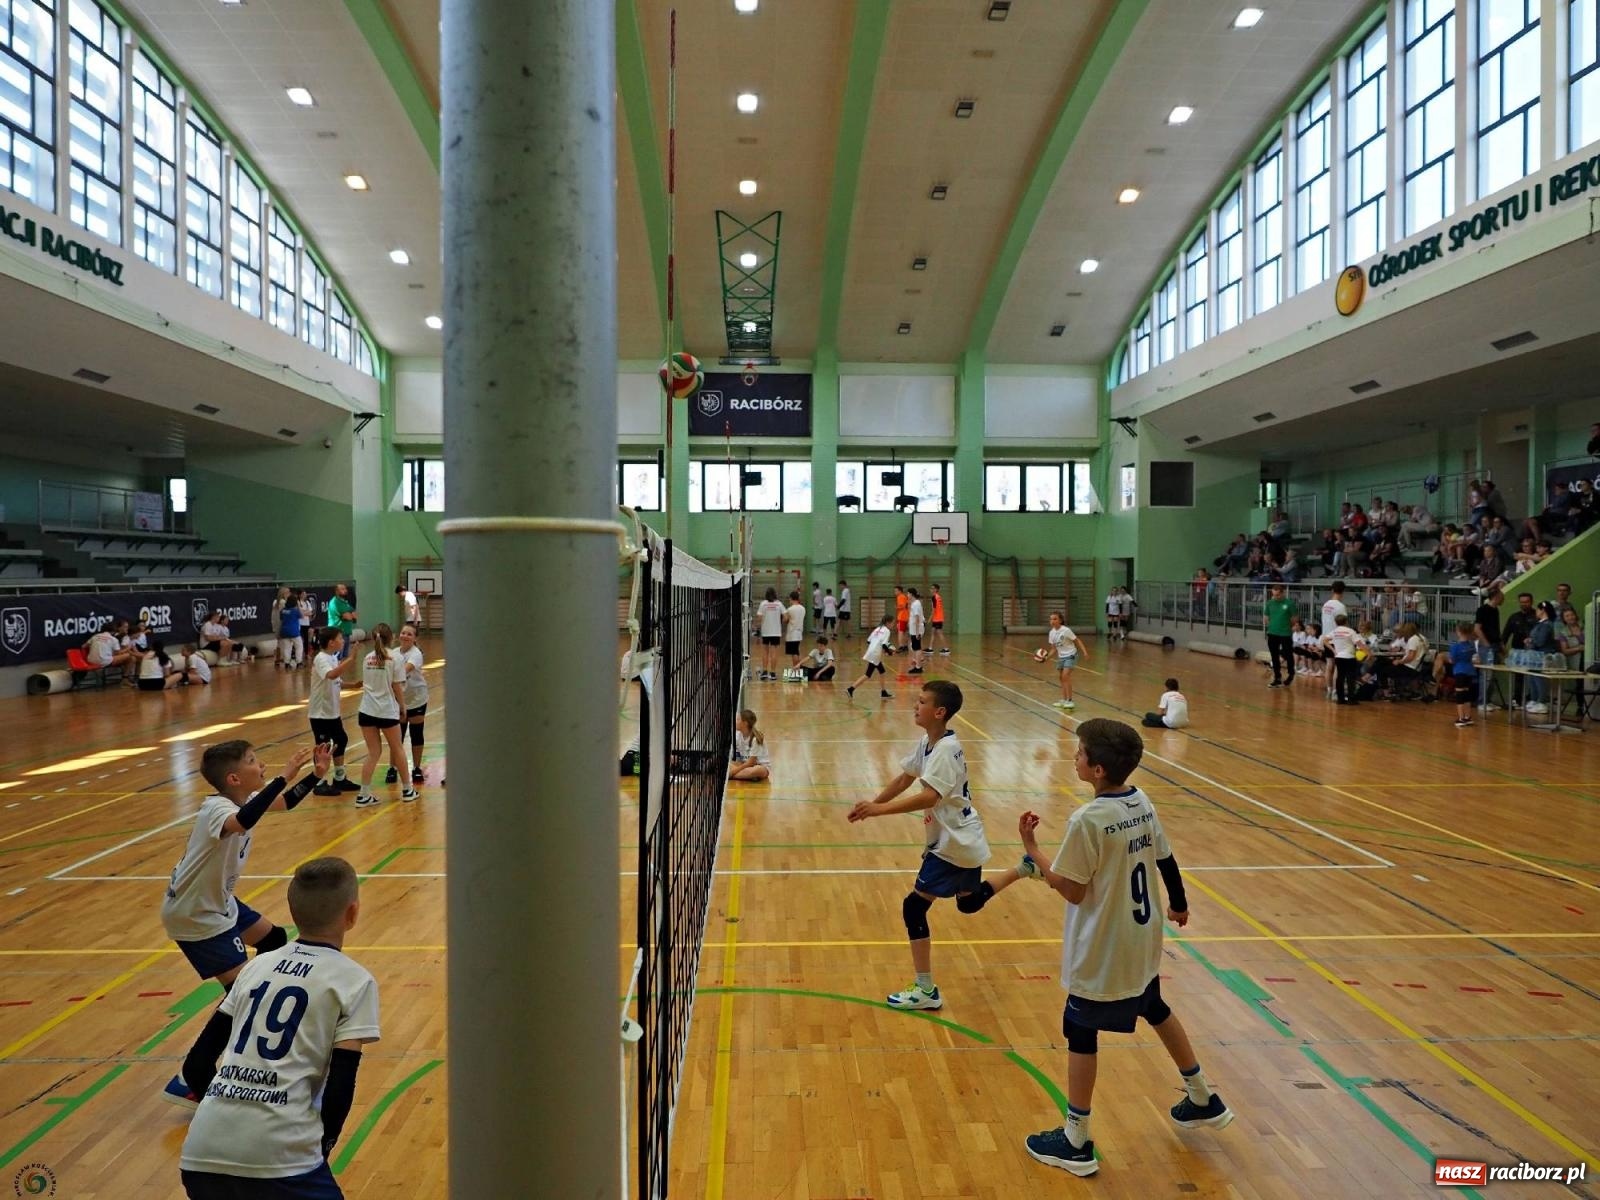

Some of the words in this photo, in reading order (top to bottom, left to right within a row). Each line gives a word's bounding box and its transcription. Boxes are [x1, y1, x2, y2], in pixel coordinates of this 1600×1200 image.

[1368, 232, 1444, 288] OŚRODEK
[1448, 189, 1529, 252] SPORTU
[1534, 183, 1543, 213] I
[1550, 153, 1600, 206] REK
[41, 226, 124, 286] RACIBÓRZ
[730, 396, 802, 411] RACIBÓRZ
[1103, 824, 1116, 835] TS
[1116, 816, 1140, 831] VOLLEY
[1131, 862, 1151, 925] 9
[232, 936, 245, 953] 8
[273, 959, 314, 978] ALAN
[233, 980, 309, 1061] 19
[227, 1084, 288, 1106] SPORTOWA
